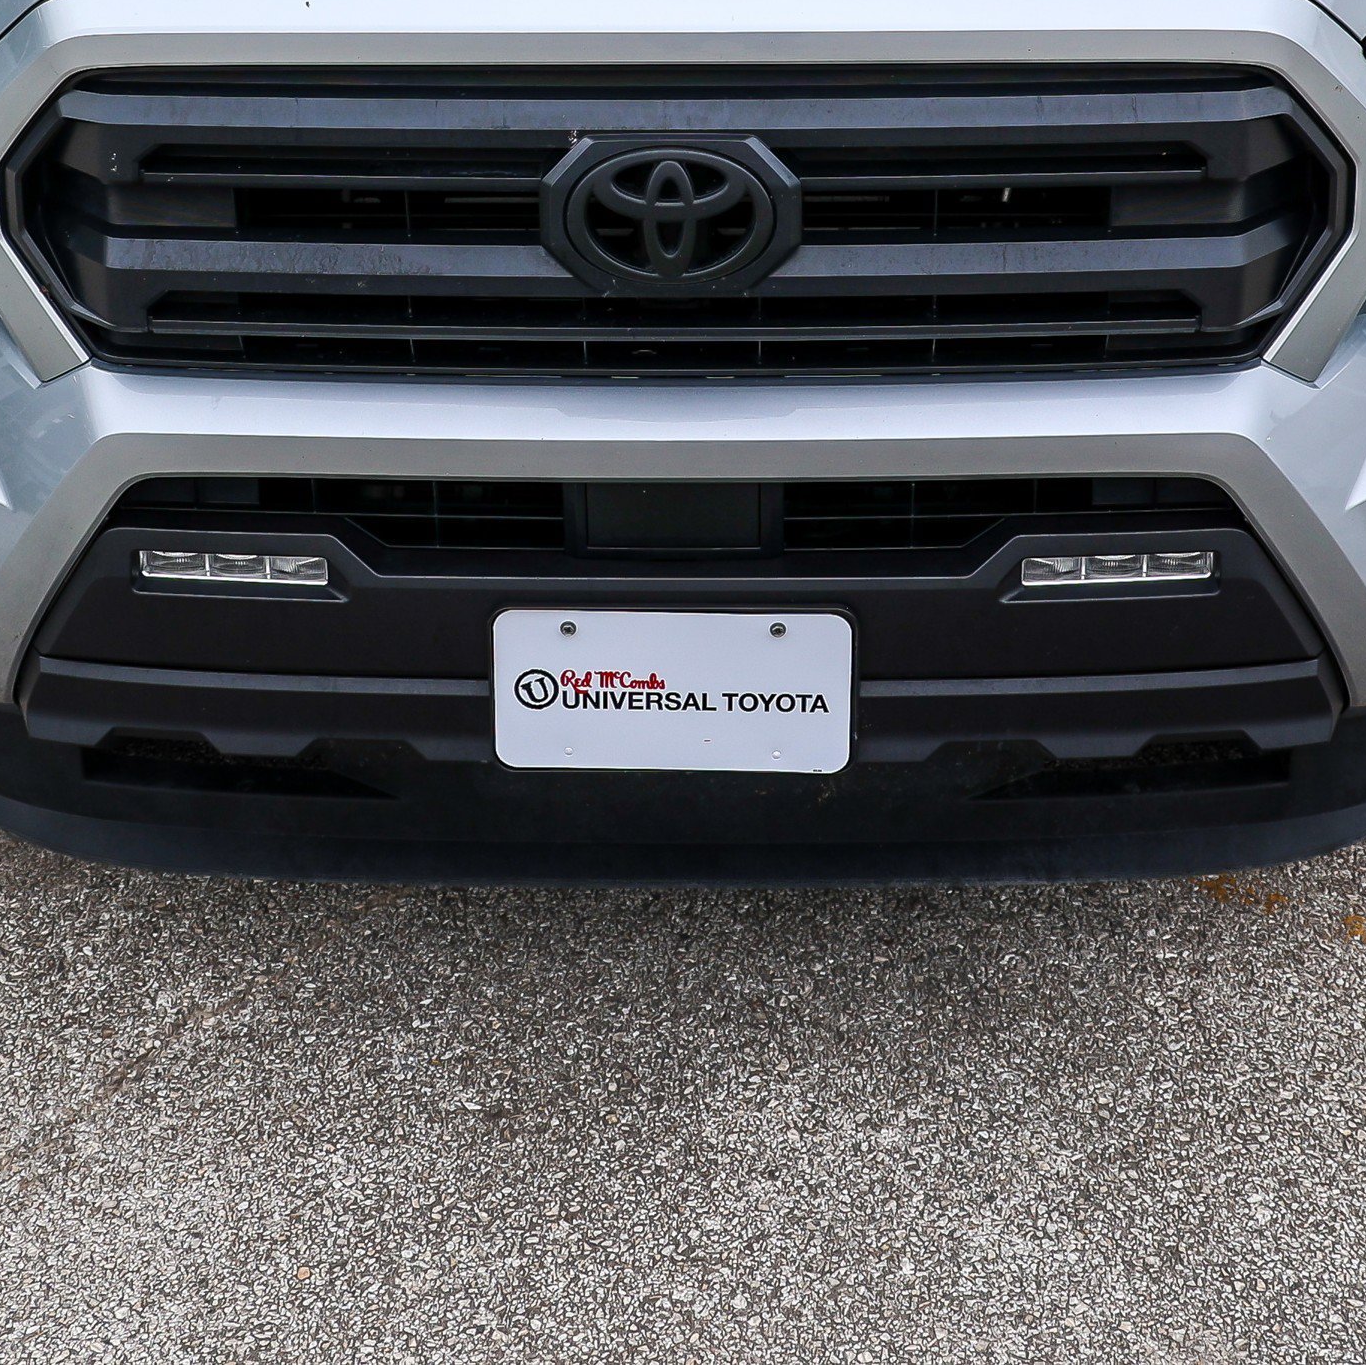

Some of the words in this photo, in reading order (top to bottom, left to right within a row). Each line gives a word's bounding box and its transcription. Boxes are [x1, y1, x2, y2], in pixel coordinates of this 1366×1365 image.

[560, 669, 593, 694] Red
[594, 670, 666, 690] McCombs
[562, 690, 717, 712] UNIVERSAL
[722, 693, 830, 714] TOYOTA
